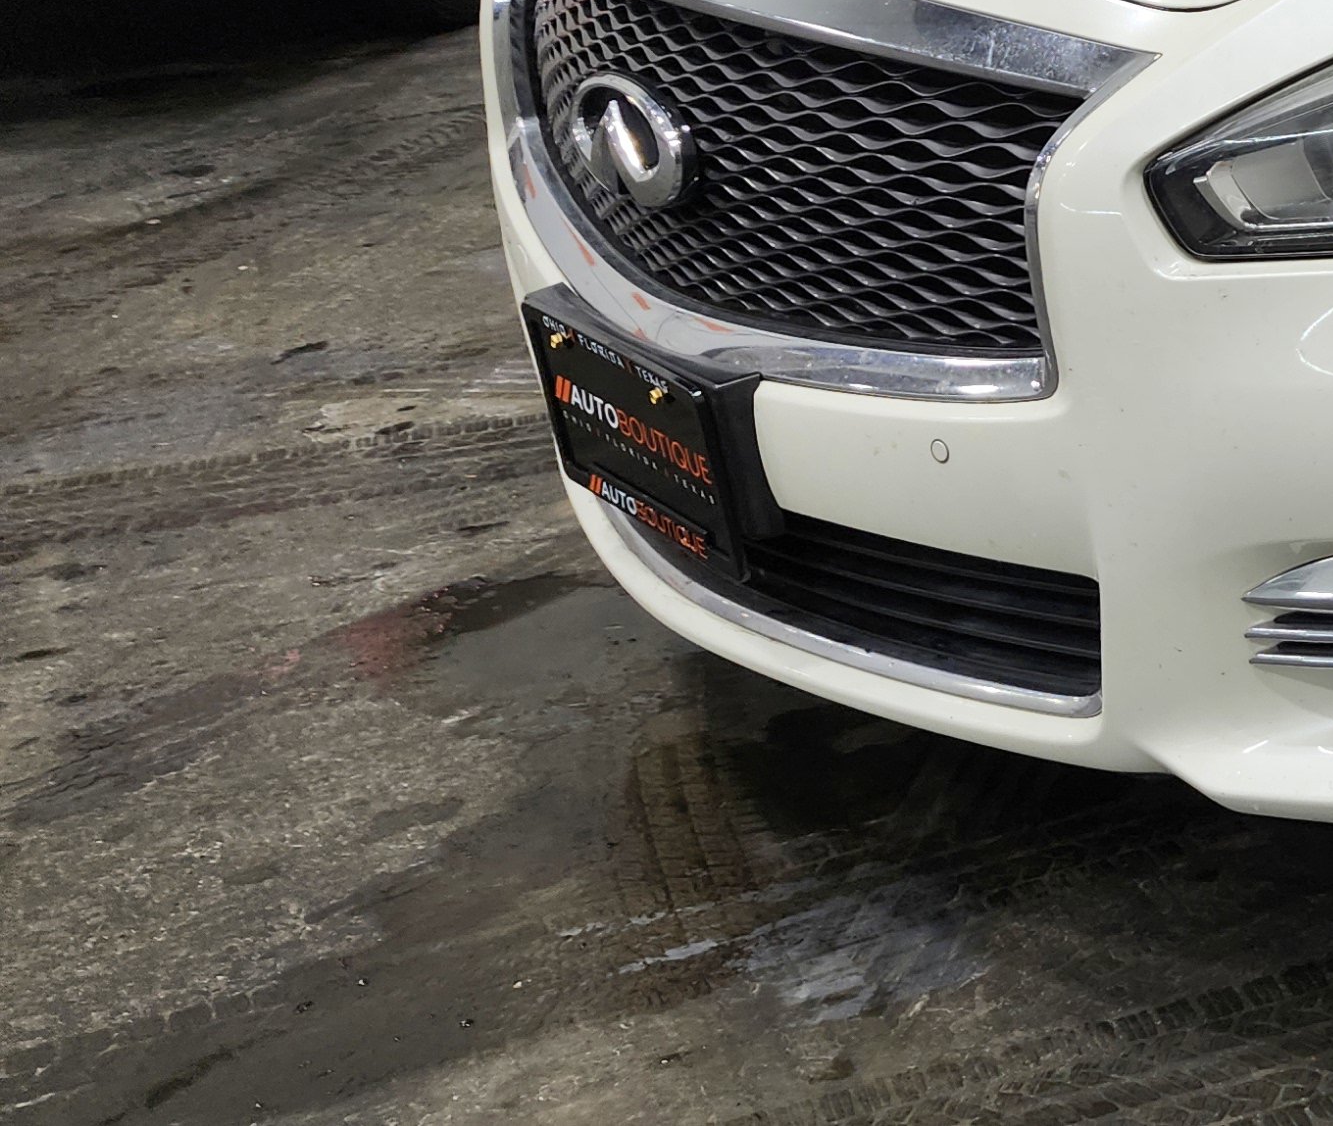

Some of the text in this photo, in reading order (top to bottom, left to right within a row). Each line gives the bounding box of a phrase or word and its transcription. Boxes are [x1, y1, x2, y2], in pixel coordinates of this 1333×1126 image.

[577, 333, 625, 370] FLORIDA
[570, 384, 713, 485] AUTOBOUTIQUE
[601, 481, 709, 560] AUTOBOUTIQUE
